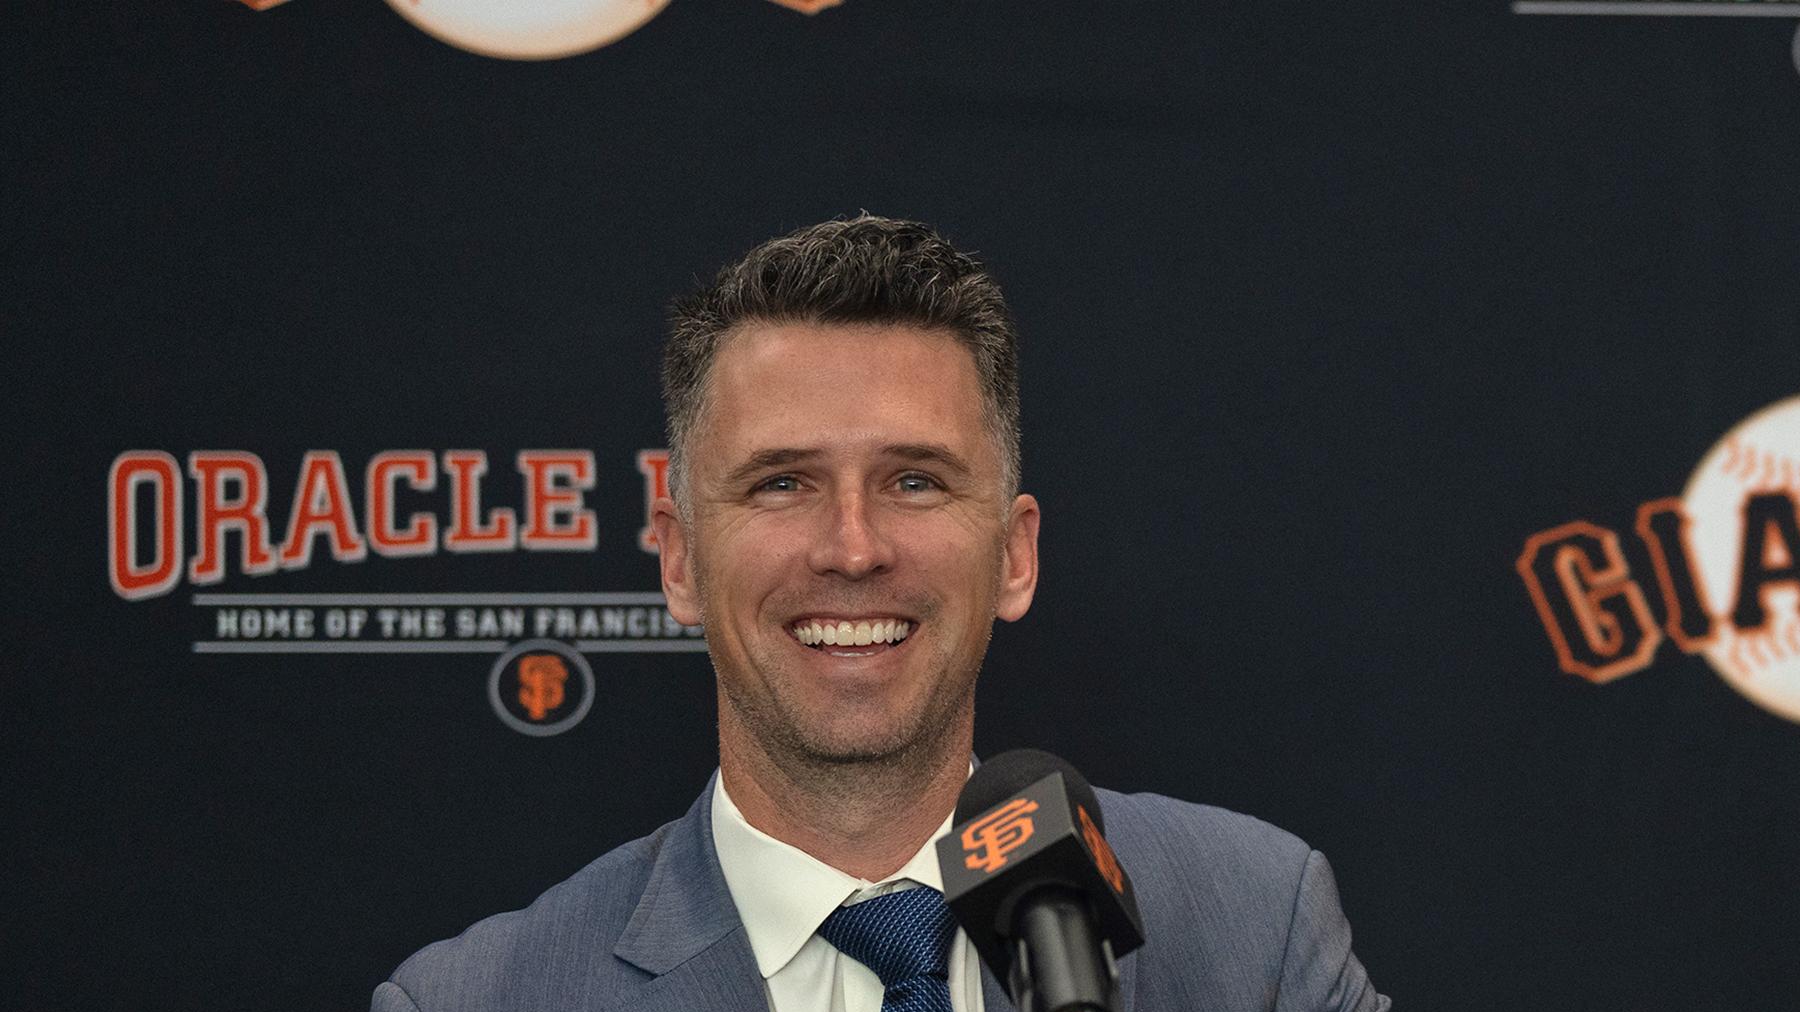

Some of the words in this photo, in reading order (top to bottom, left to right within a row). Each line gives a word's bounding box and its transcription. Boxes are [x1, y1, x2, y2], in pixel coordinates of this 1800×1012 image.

[108, 450, 597, 600] ORACLE
[216, 608, 314, 638] HOME
[325, 608, 368, 638] OF
[378, 608, 446, 638] THE
[455, 607, 525, 638] SAN
[532, 607, 706, 639] FRANCIS
